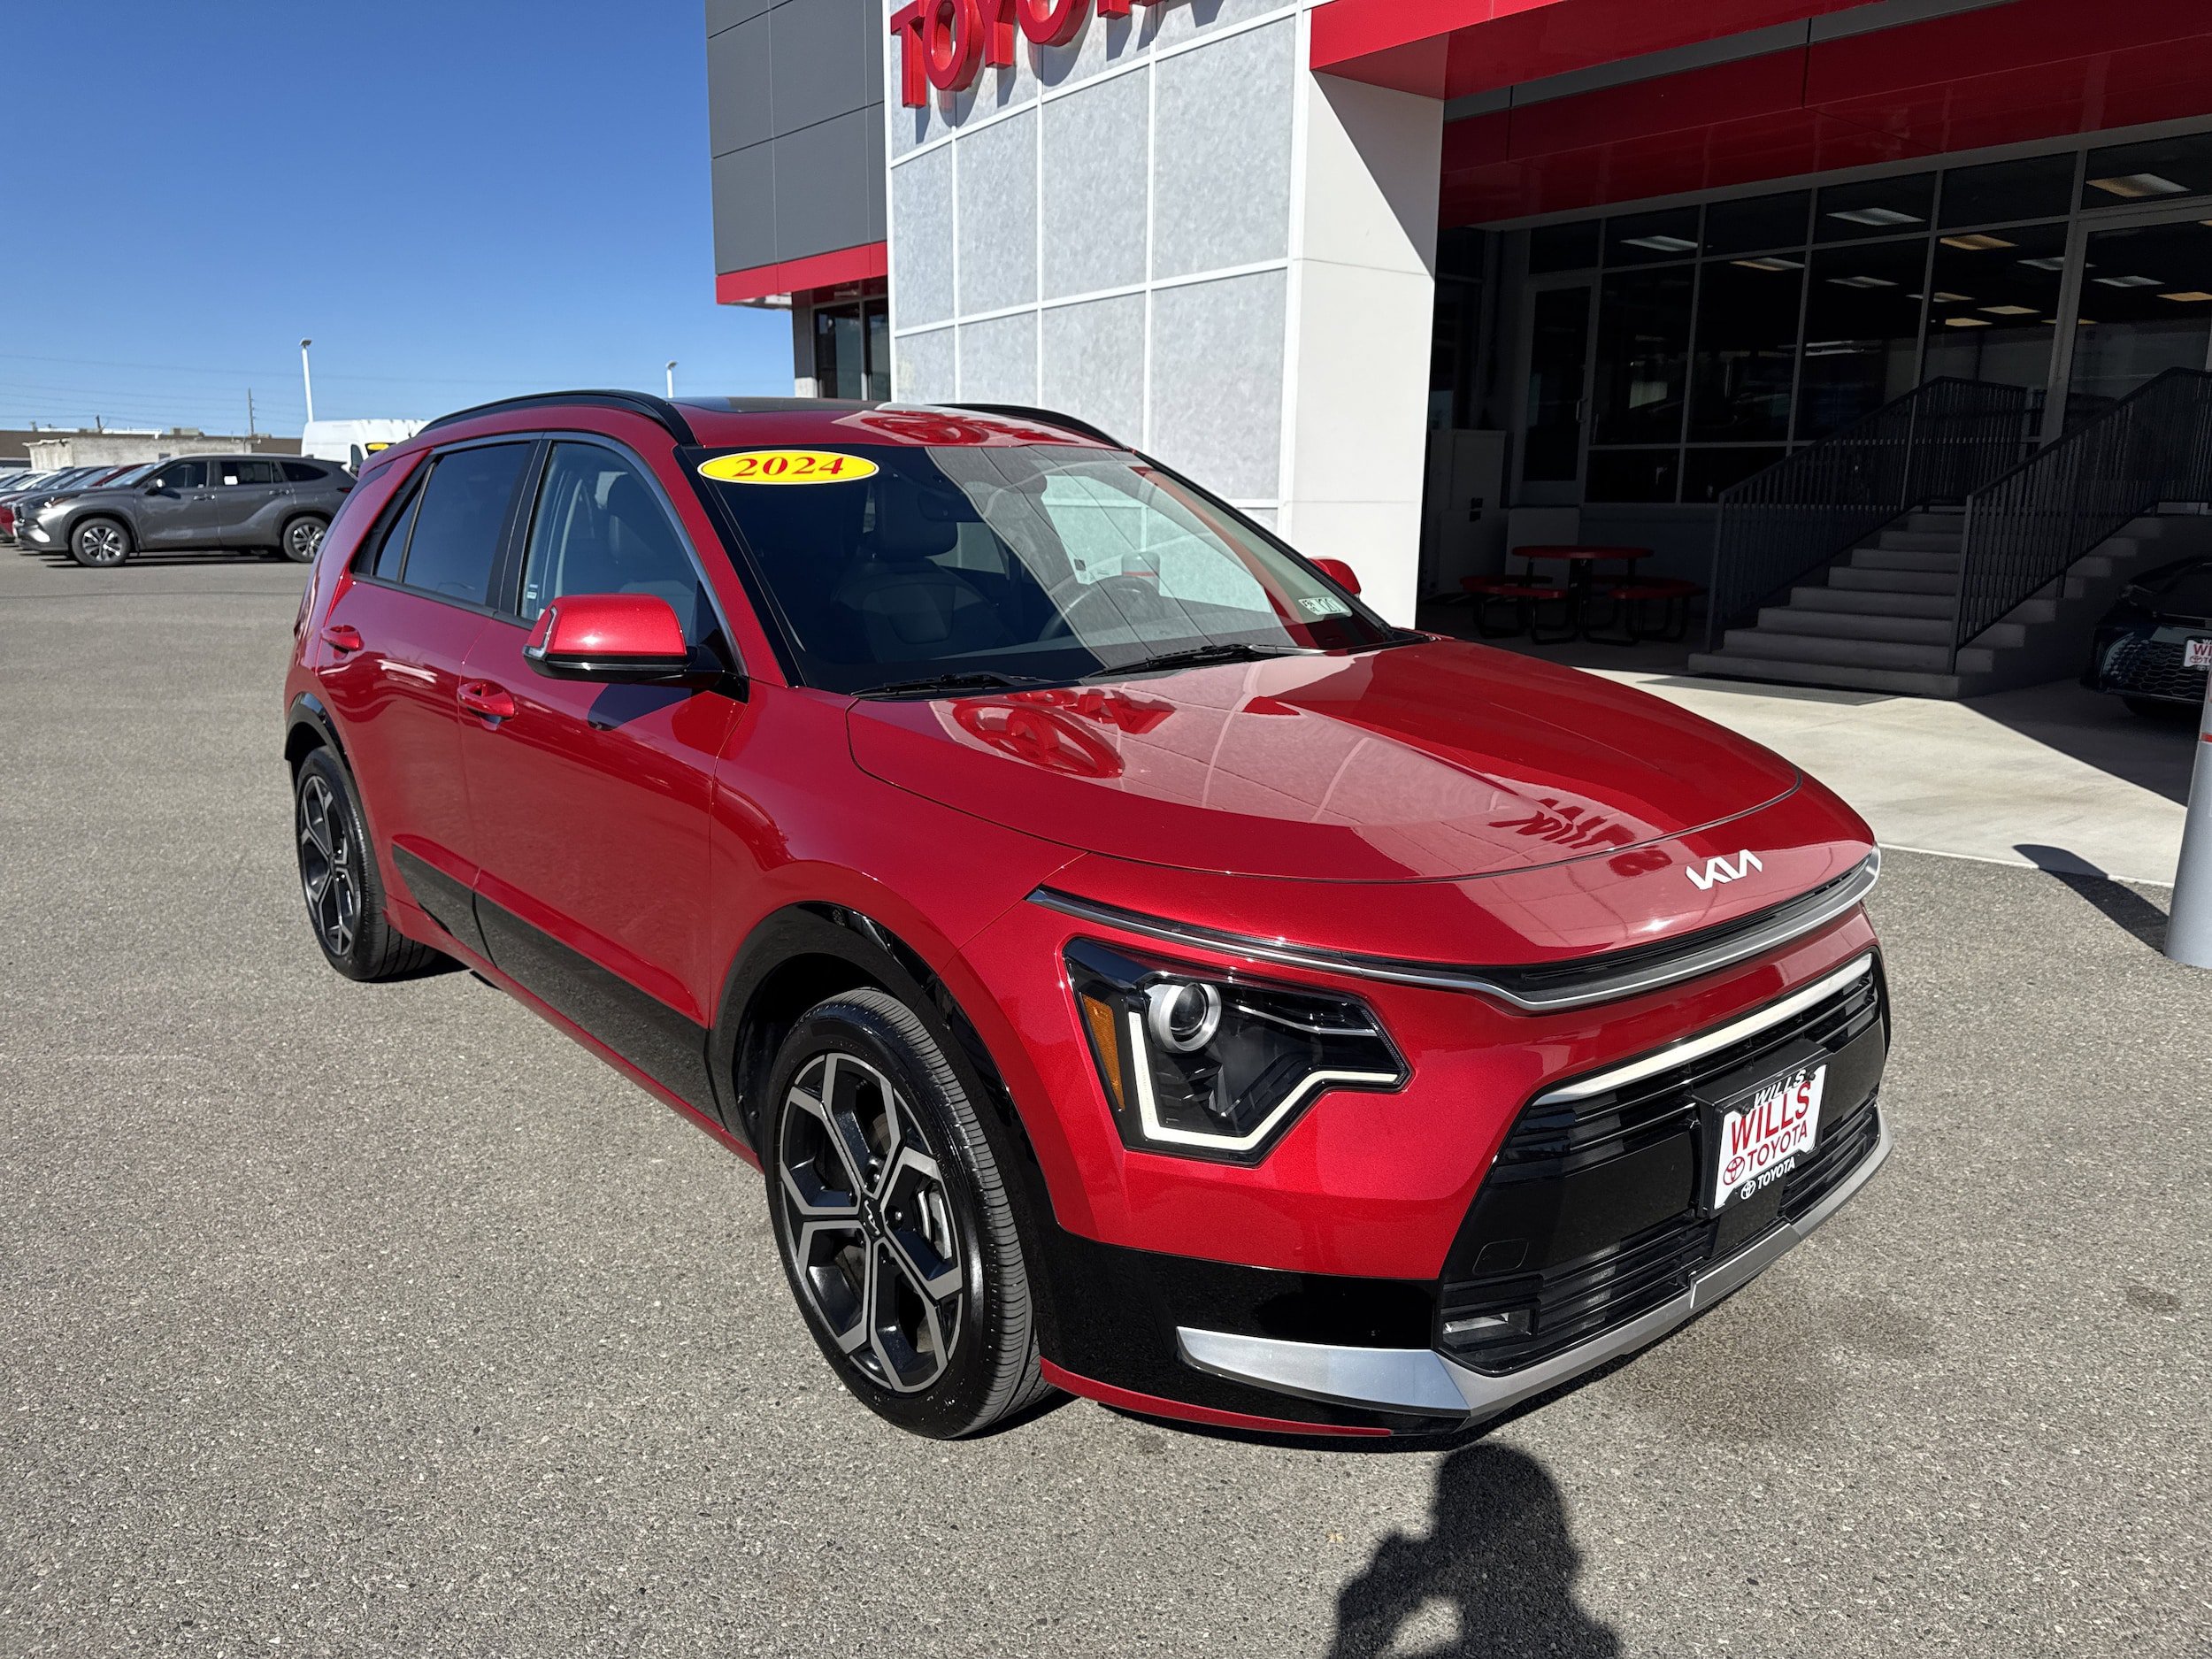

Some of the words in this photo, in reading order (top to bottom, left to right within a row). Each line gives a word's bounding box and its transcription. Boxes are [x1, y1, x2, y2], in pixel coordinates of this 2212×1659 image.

[890, 0, 1164, 107] TOY
[733, 457, 844, 477] 2024
[1686, 849, 1763, 890] KIA
[1754, 1069, 1806, 1107] WILLS
[1732, 1080, 1811, 1156] WILLS
[1747, 1119, 1808, 1171] TOYOTA
[1757, 1156, 1795, 1189] TOYOTA
